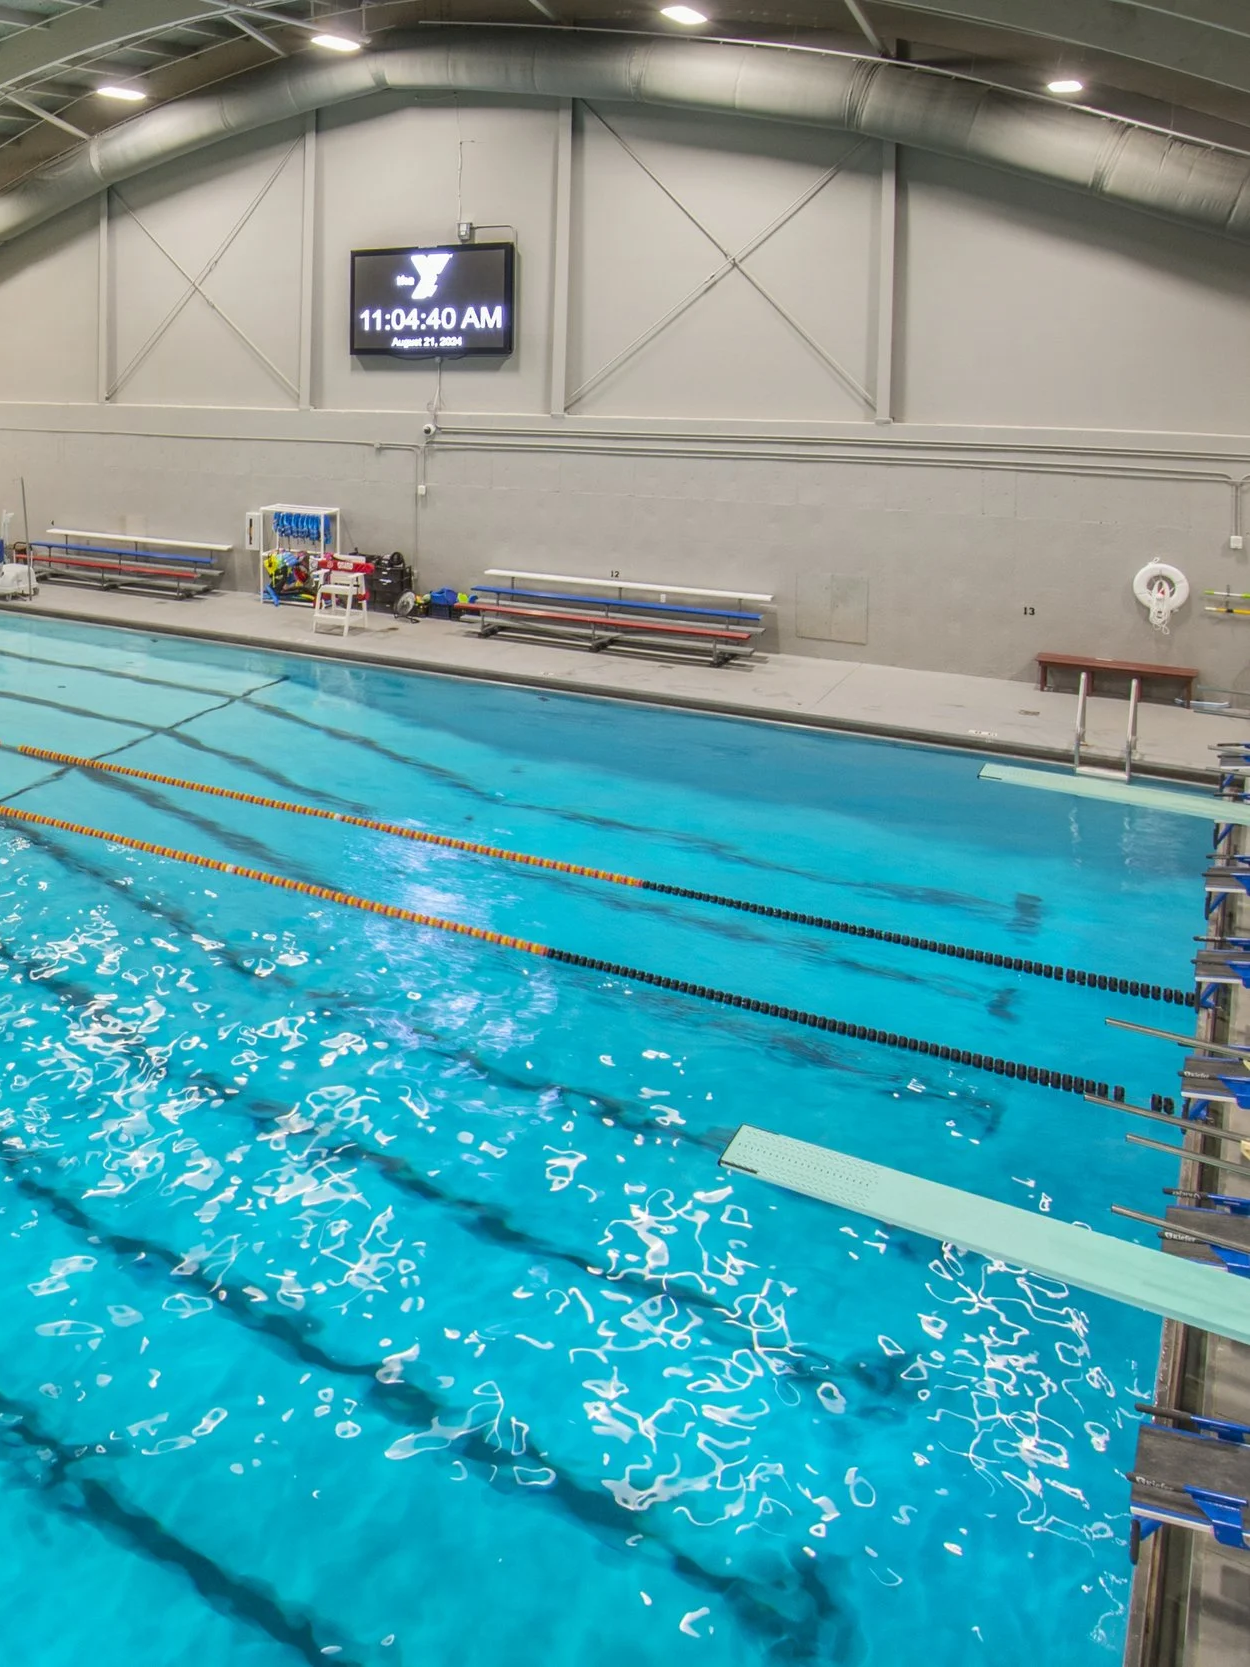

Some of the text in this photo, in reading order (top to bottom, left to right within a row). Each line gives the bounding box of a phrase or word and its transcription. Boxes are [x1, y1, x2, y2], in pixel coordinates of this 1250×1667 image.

[360, 305, 503, 331] 11:04:40 AM
[391, 336, 463, 348] August 21, 2024
[610, 570, 620, 578] 12
[1023, 606, 1035, 616] 13
